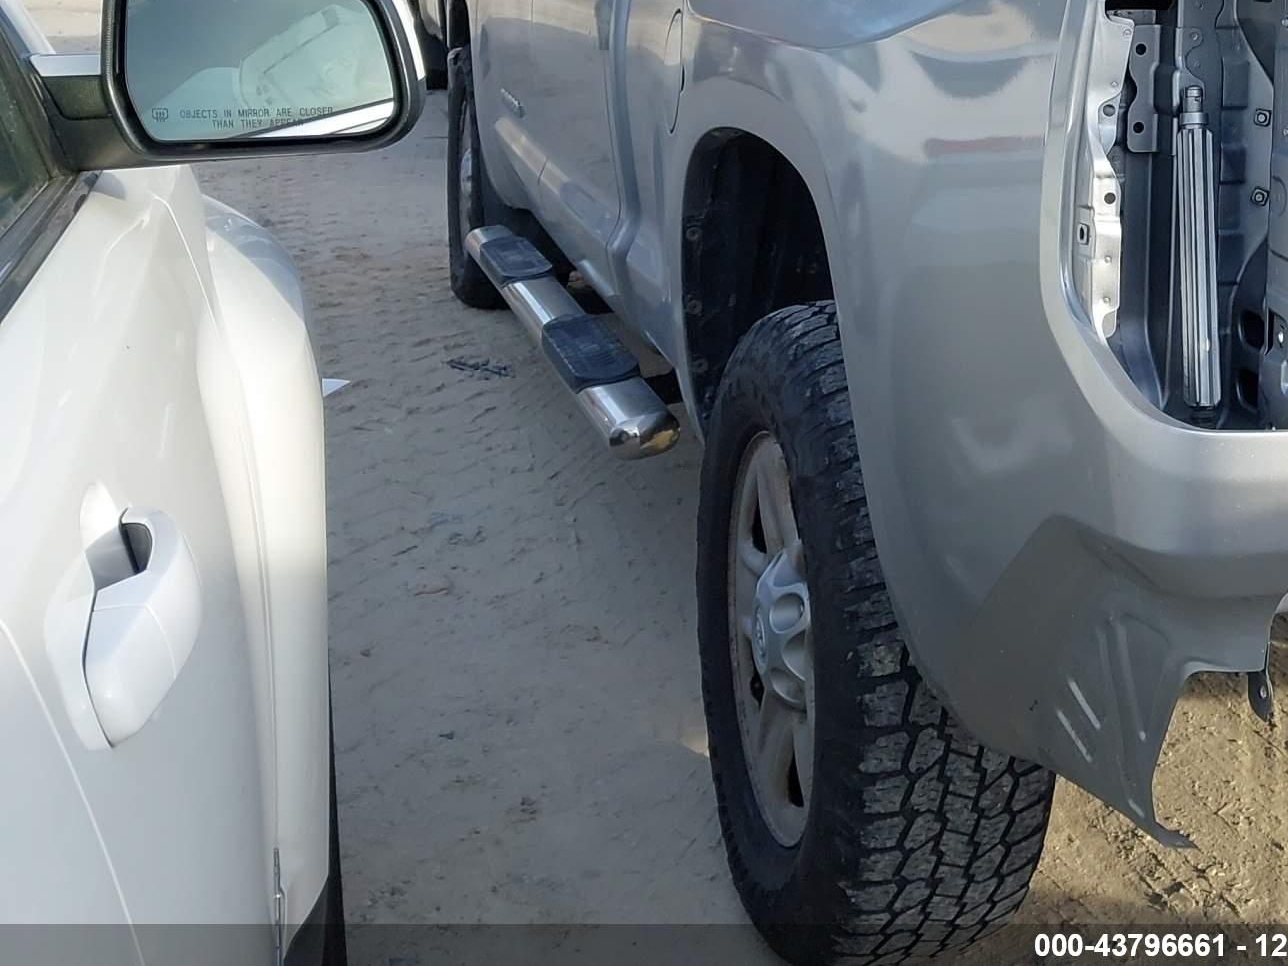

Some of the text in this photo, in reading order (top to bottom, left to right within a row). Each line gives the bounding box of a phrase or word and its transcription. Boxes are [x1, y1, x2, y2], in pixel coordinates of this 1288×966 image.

[180, 107, 333, 119] OBJECTS IN MIRROR ARE CLOSER
[212, 120, 234, 129] THAN
[240, 119, 262, 128] THEY
